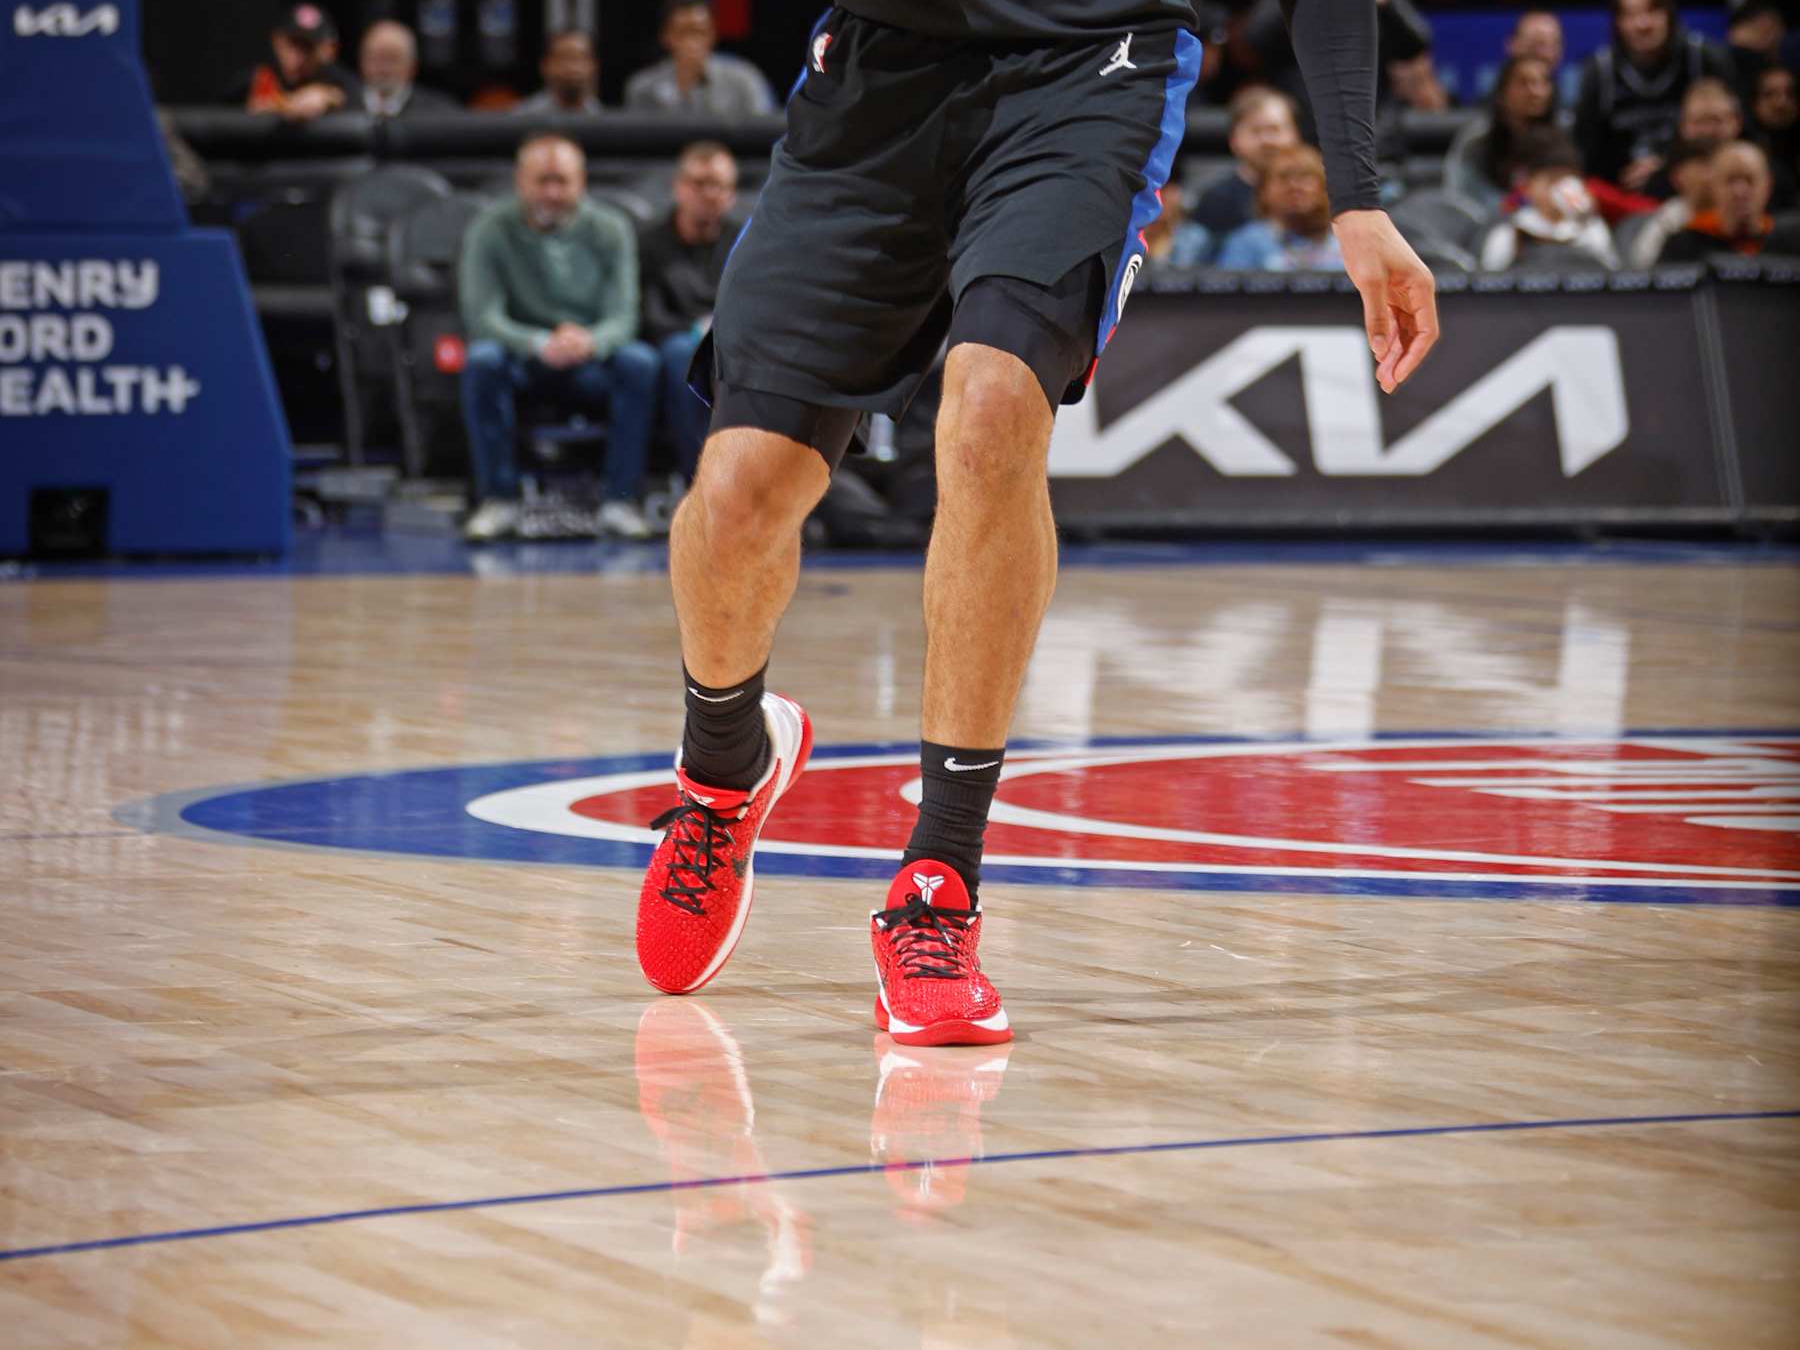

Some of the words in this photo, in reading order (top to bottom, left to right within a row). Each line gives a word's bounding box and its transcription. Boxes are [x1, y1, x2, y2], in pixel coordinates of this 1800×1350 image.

[0, 259, 159, 310] ENRY
[0, 313, 114, 363] ORD
[1048, 325, 1629, 478] KIA
